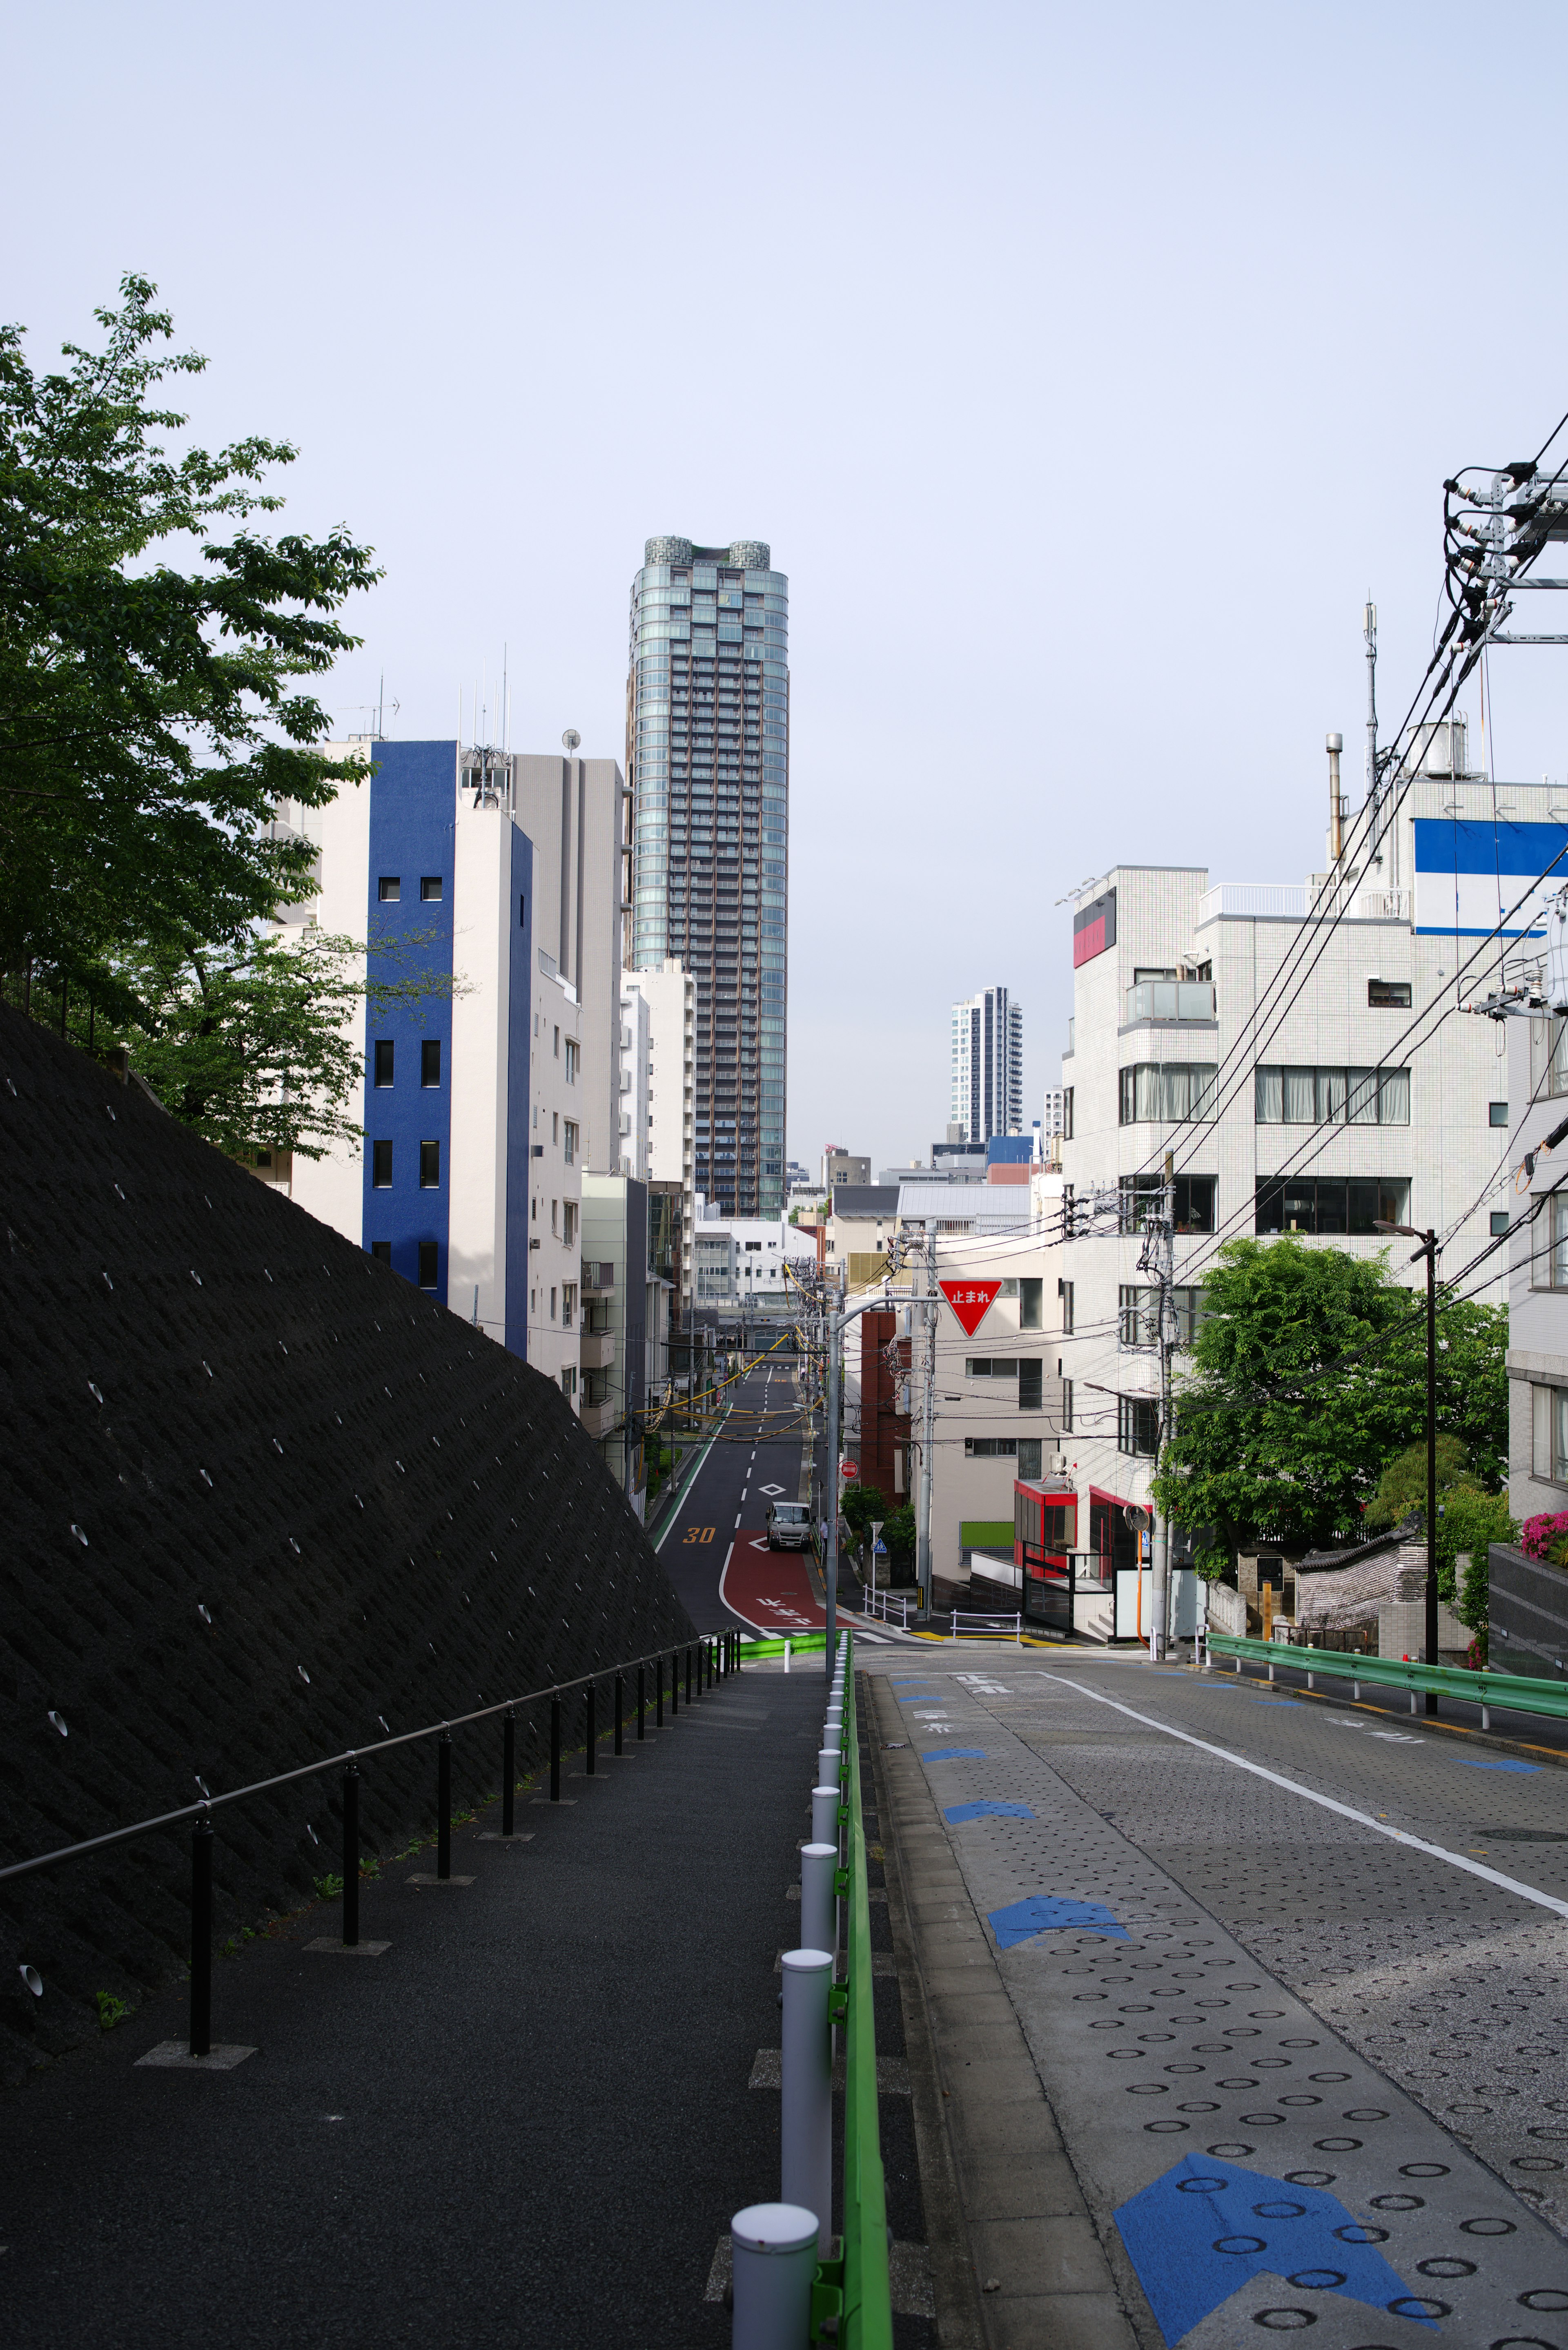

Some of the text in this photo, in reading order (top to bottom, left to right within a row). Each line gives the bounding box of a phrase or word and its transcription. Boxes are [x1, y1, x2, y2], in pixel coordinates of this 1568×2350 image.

[1075, 929, 1104, 954] AKASAK
[951, 1291, 990, 1303] 止まれ
[682, 1527, 716, 1543] 30
[756, 1598, 813, 1625] 止まれ
